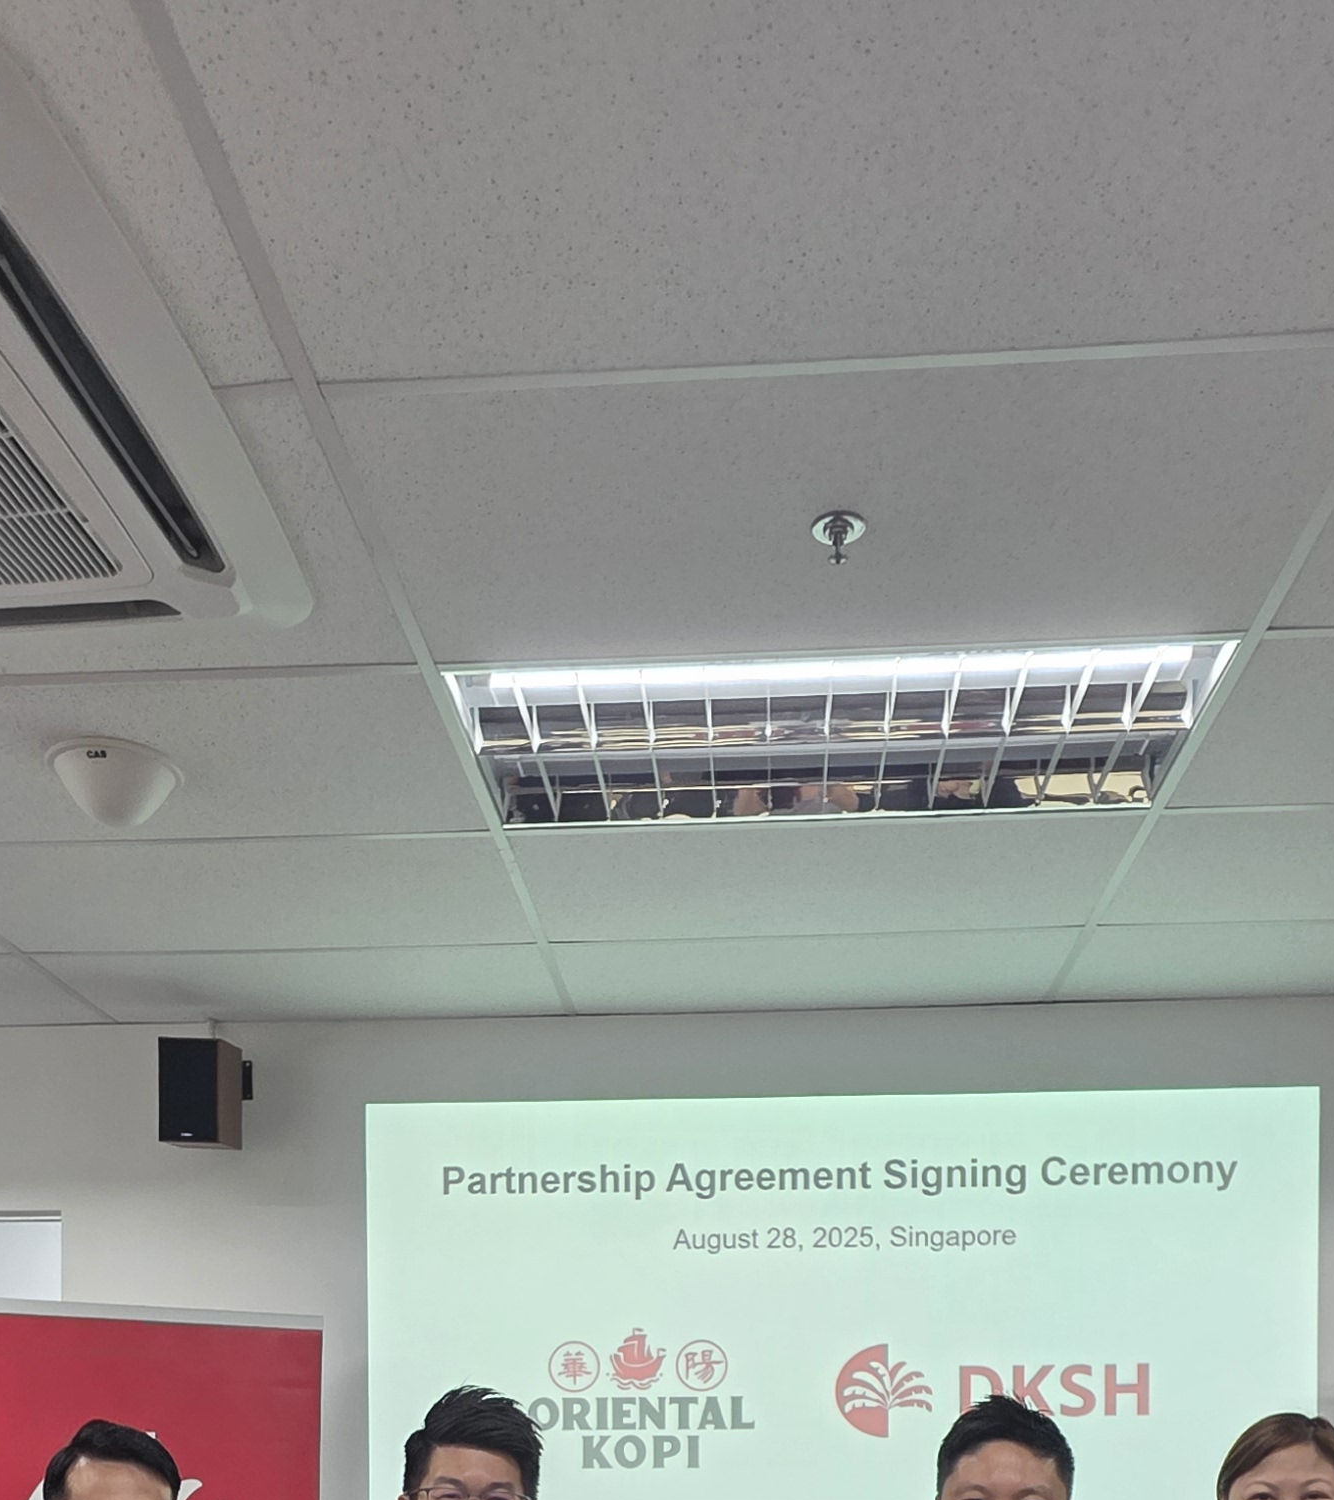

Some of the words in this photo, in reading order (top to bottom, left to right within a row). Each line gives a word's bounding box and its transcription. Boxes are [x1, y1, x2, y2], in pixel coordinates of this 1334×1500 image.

[442, 1164, 656, 1201] Partnership
[666, 1162, 872, 1199] Agreement
[883, 1158, 1028, 1196] Signing
[1041, 1155, 1239, 1191] Ceremony
[672, 1227, 760, 1255] August
[766, 1226, 804, 1252] 28,
[812, 1226, 881, 1251] 2025,
[889, 1225, 1018, 1252] Singapore
[958, 1362, 1151, 1418] DKSH
[528, 1396, 756, 1432] ORIENTAL
[581, 1434, 701, 1469] KOPI
